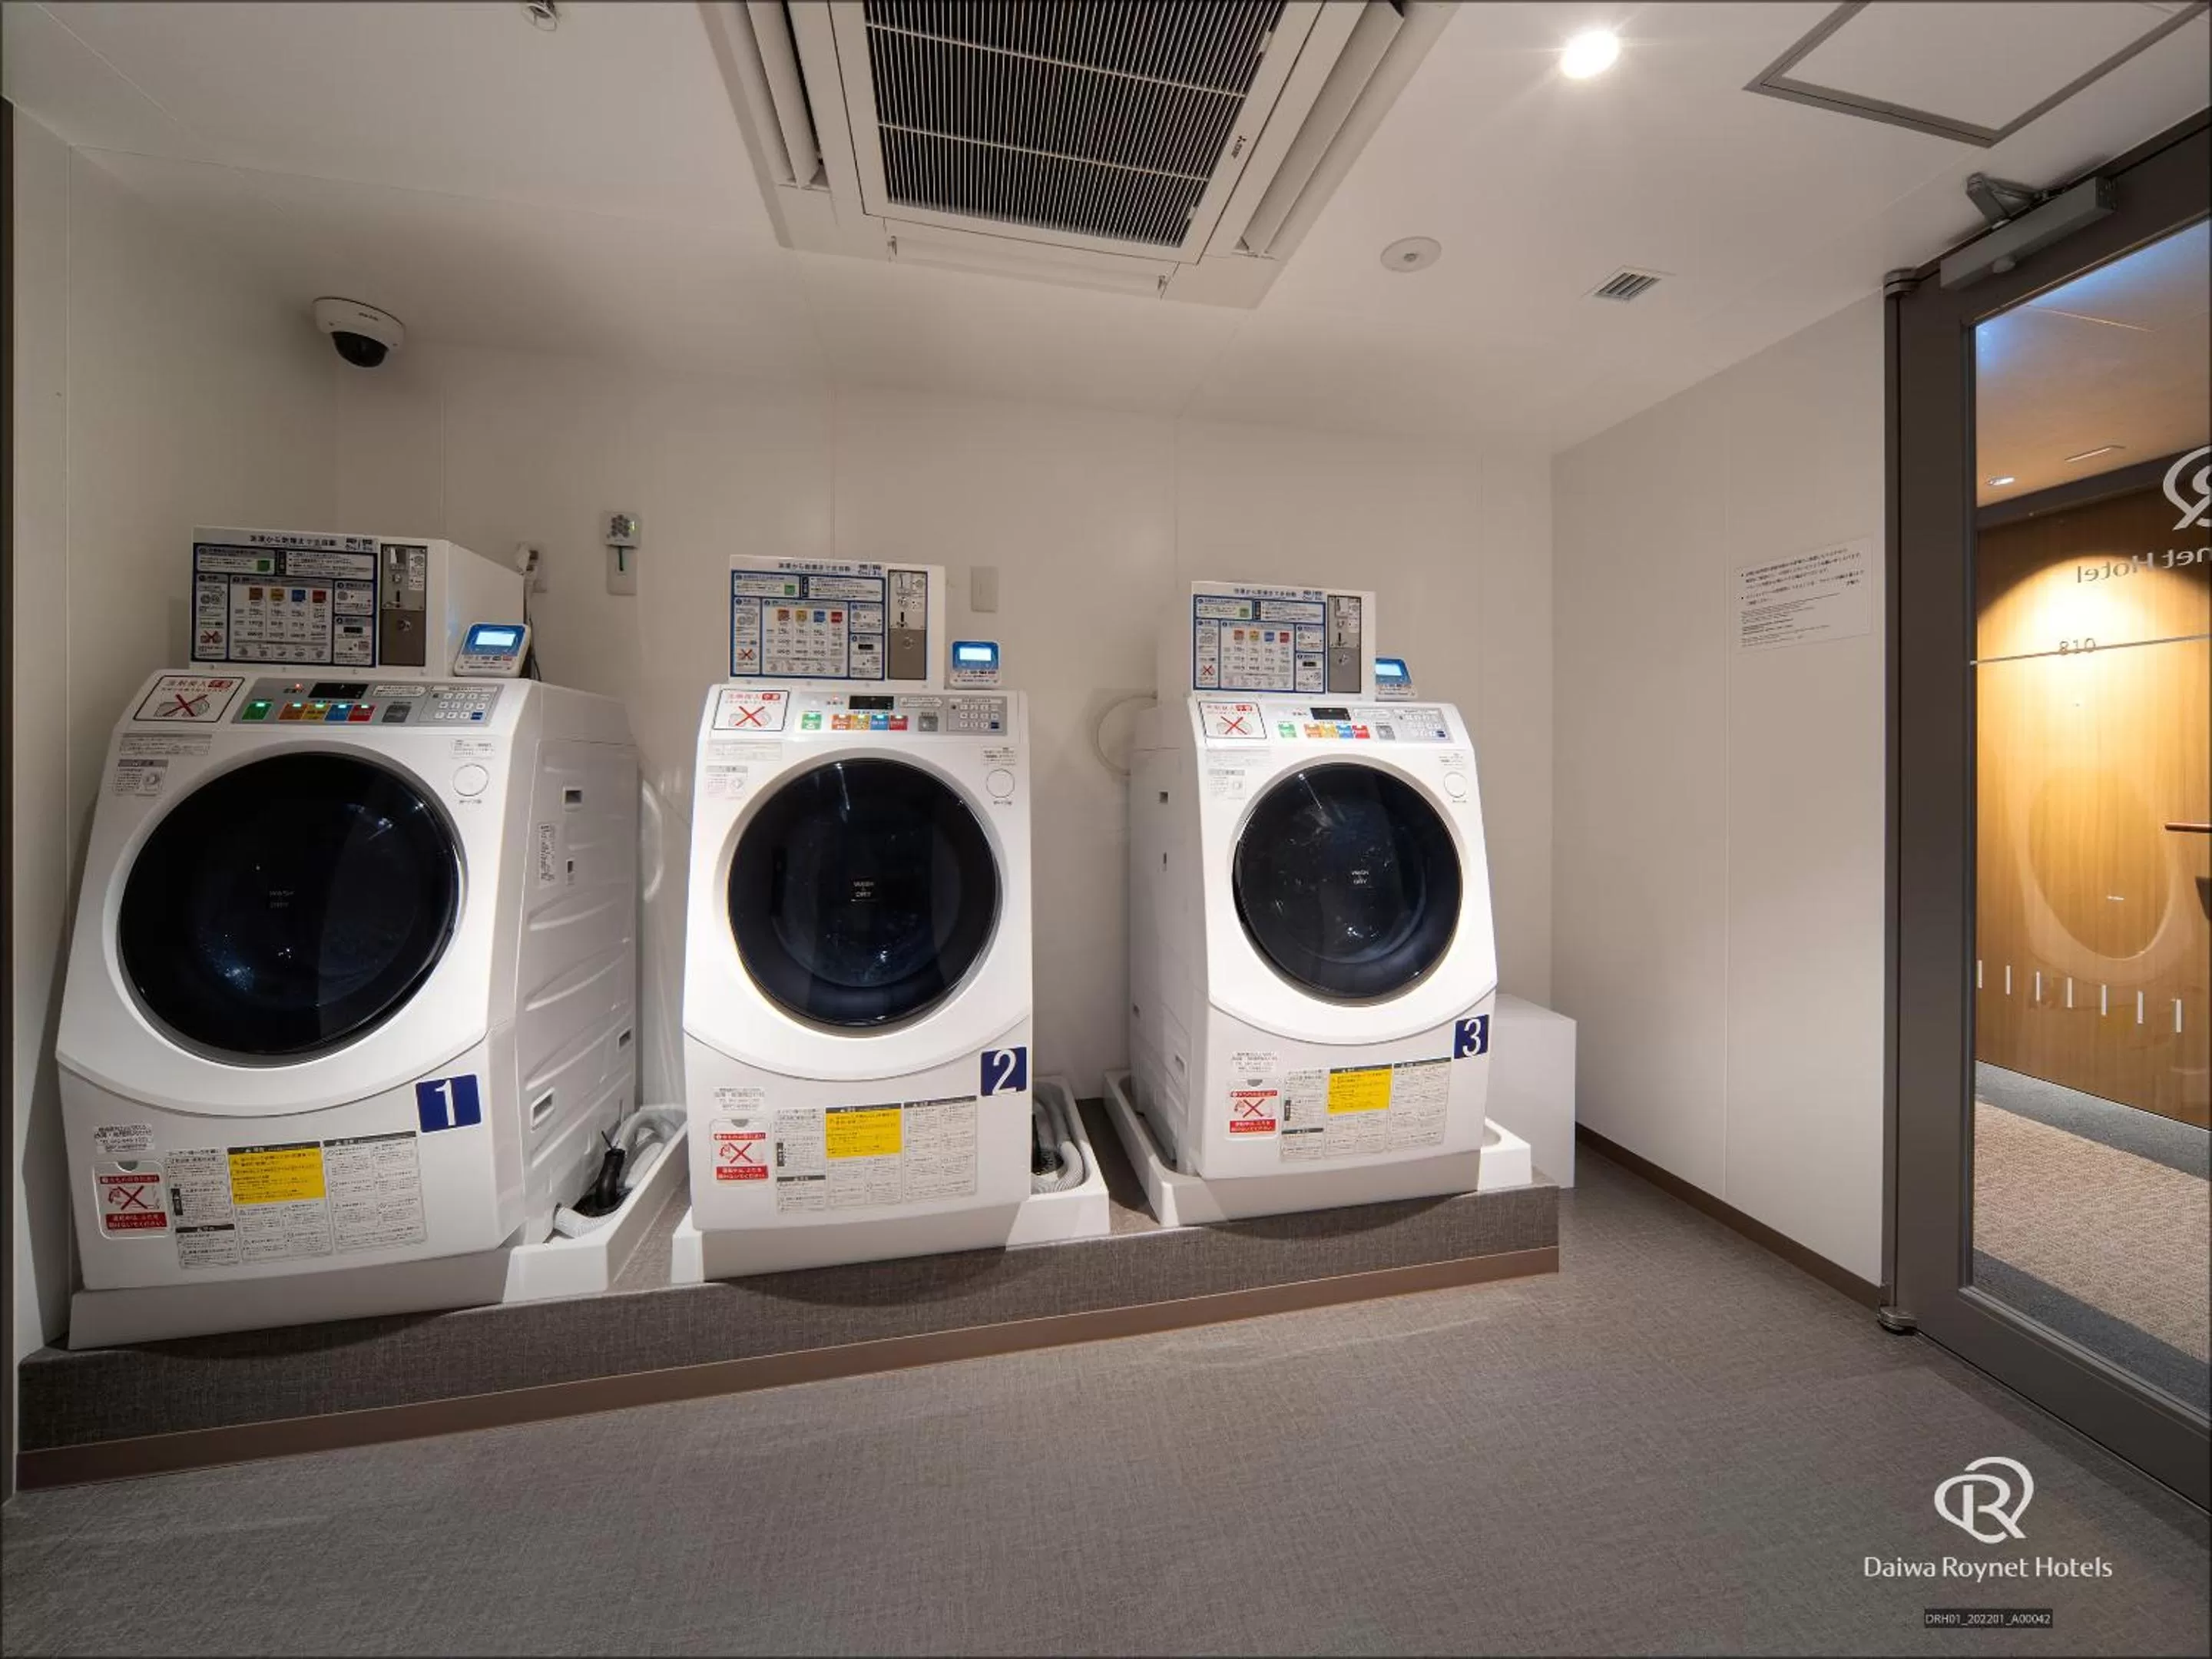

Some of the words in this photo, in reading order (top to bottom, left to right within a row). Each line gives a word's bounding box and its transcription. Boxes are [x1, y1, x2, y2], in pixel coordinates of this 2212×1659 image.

[2058, 637, 2096, 655] 810
[1462, 1018, 1481, 1057] 3
[992, 1050, 1016, 1094] 2
[435, 1079, 456, 1126] 1
